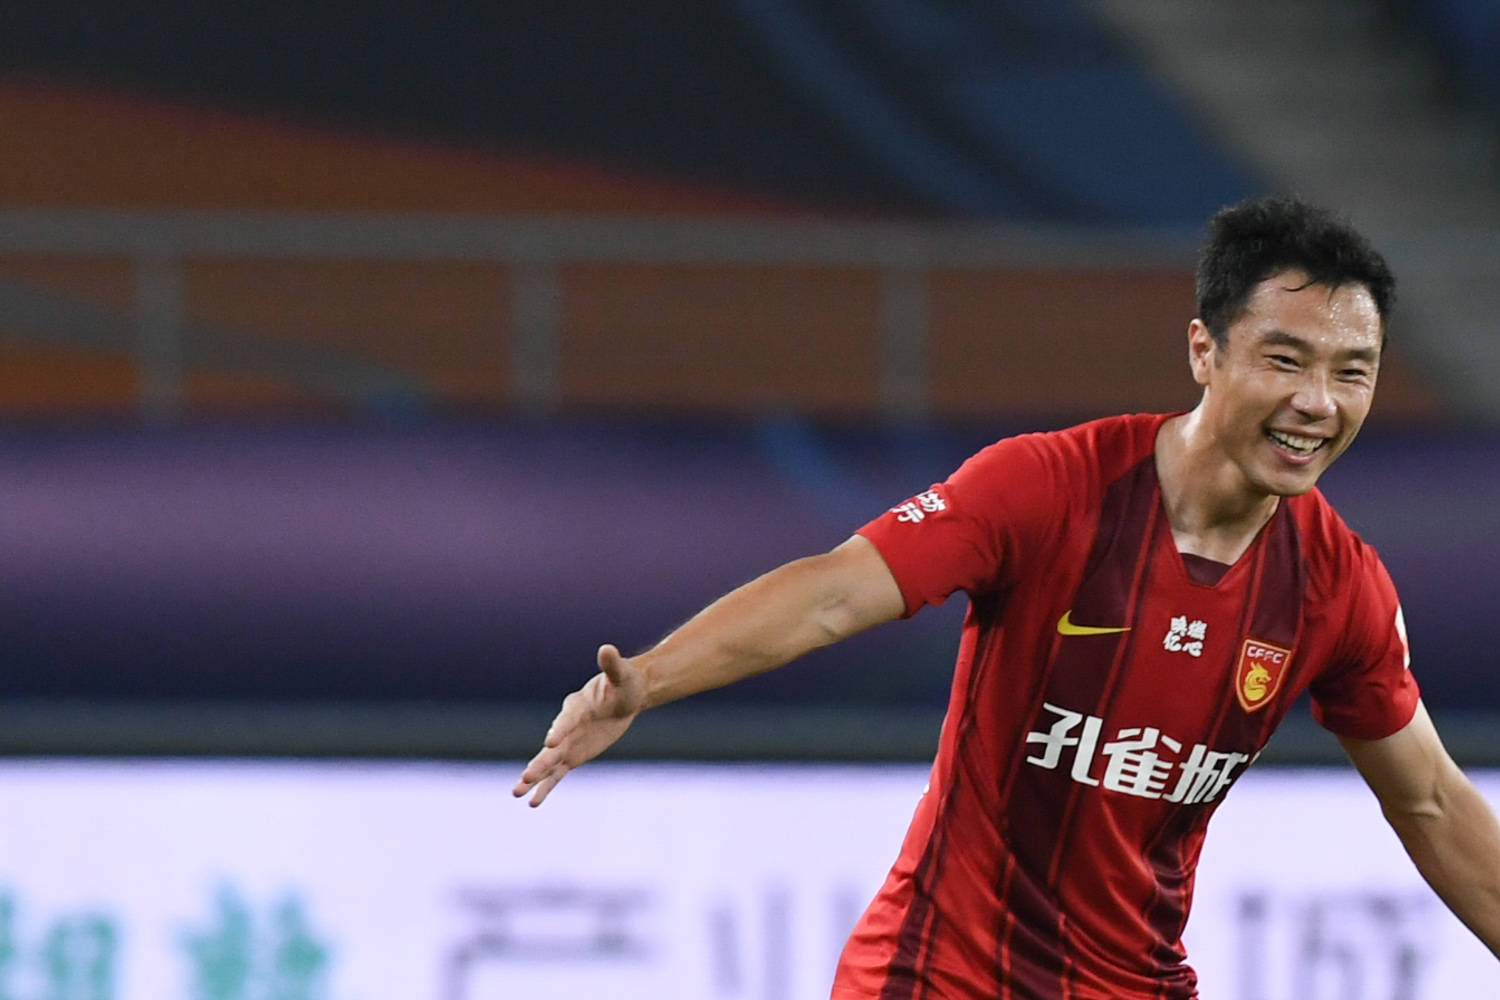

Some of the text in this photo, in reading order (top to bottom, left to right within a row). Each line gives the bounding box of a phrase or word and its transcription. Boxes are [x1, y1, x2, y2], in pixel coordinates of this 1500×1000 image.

[1247, 645, 1284, 664] CFFC
[1026, 702, 1250, 805] 孔雀城
